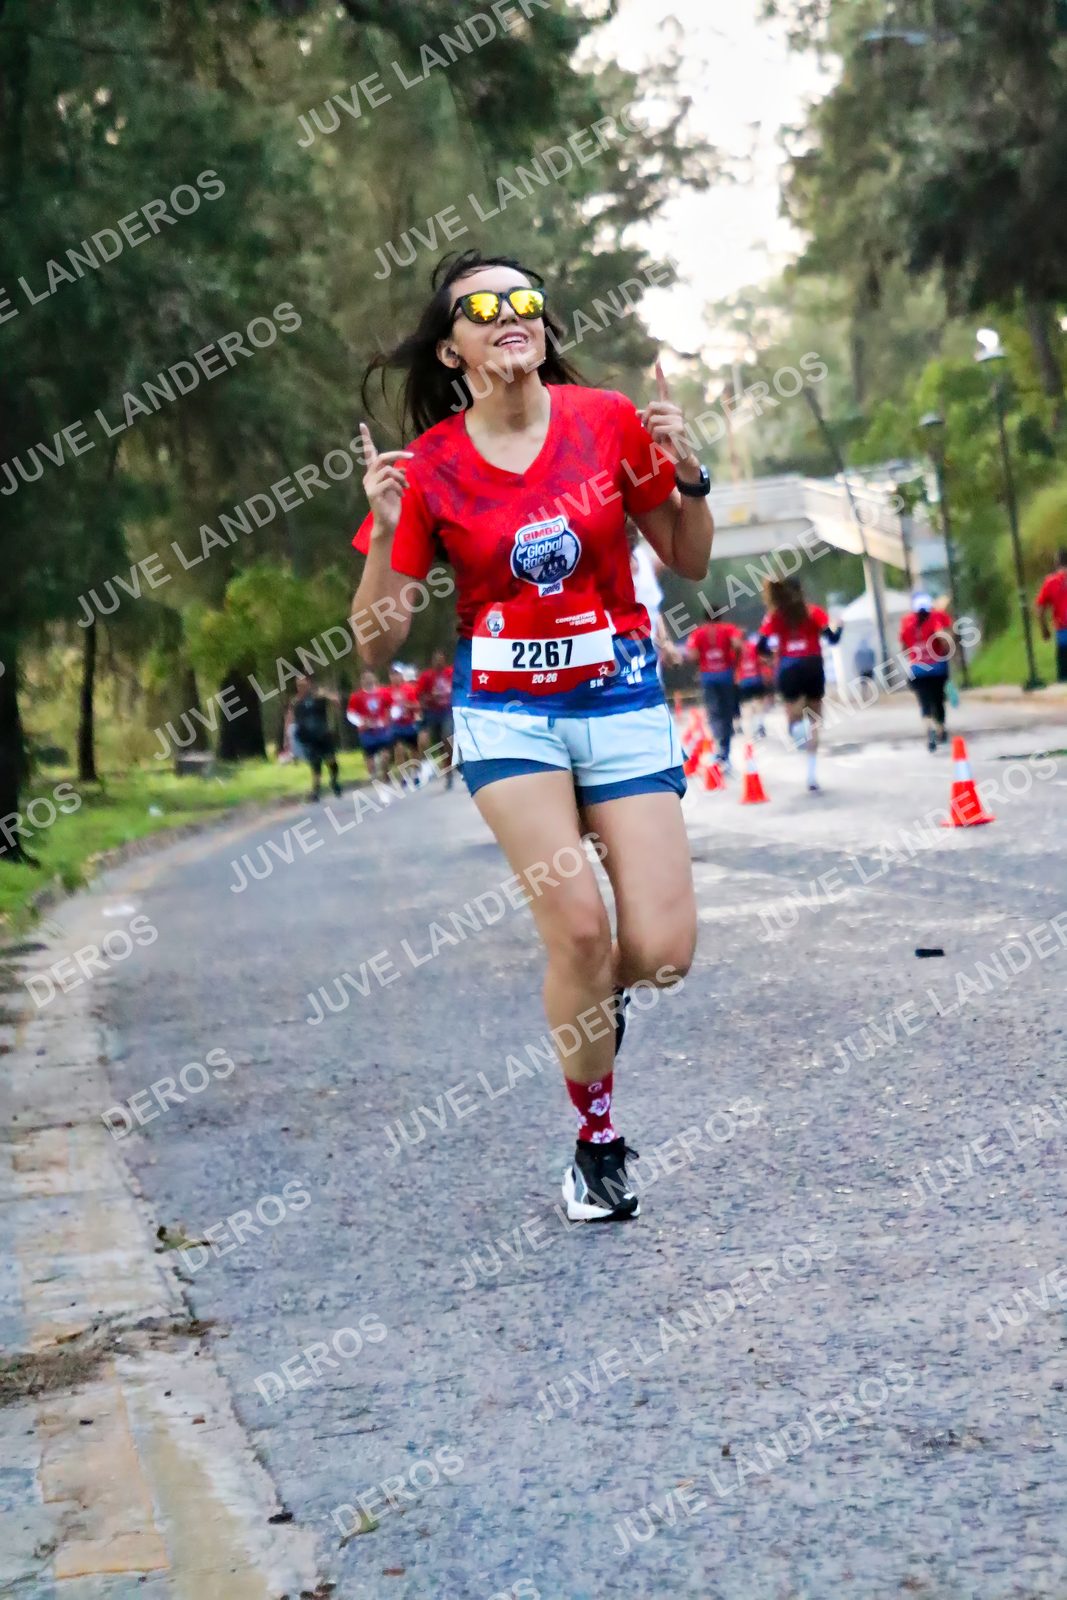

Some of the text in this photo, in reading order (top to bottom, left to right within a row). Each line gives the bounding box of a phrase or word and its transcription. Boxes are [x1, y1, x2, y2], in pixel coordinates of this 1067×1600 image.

[523, 524, 562, 543] BIMBO
[527, 536, 563, 559] Global
[522, 553, 552, 571] Race
[512, 639, 573, 669] 2267
